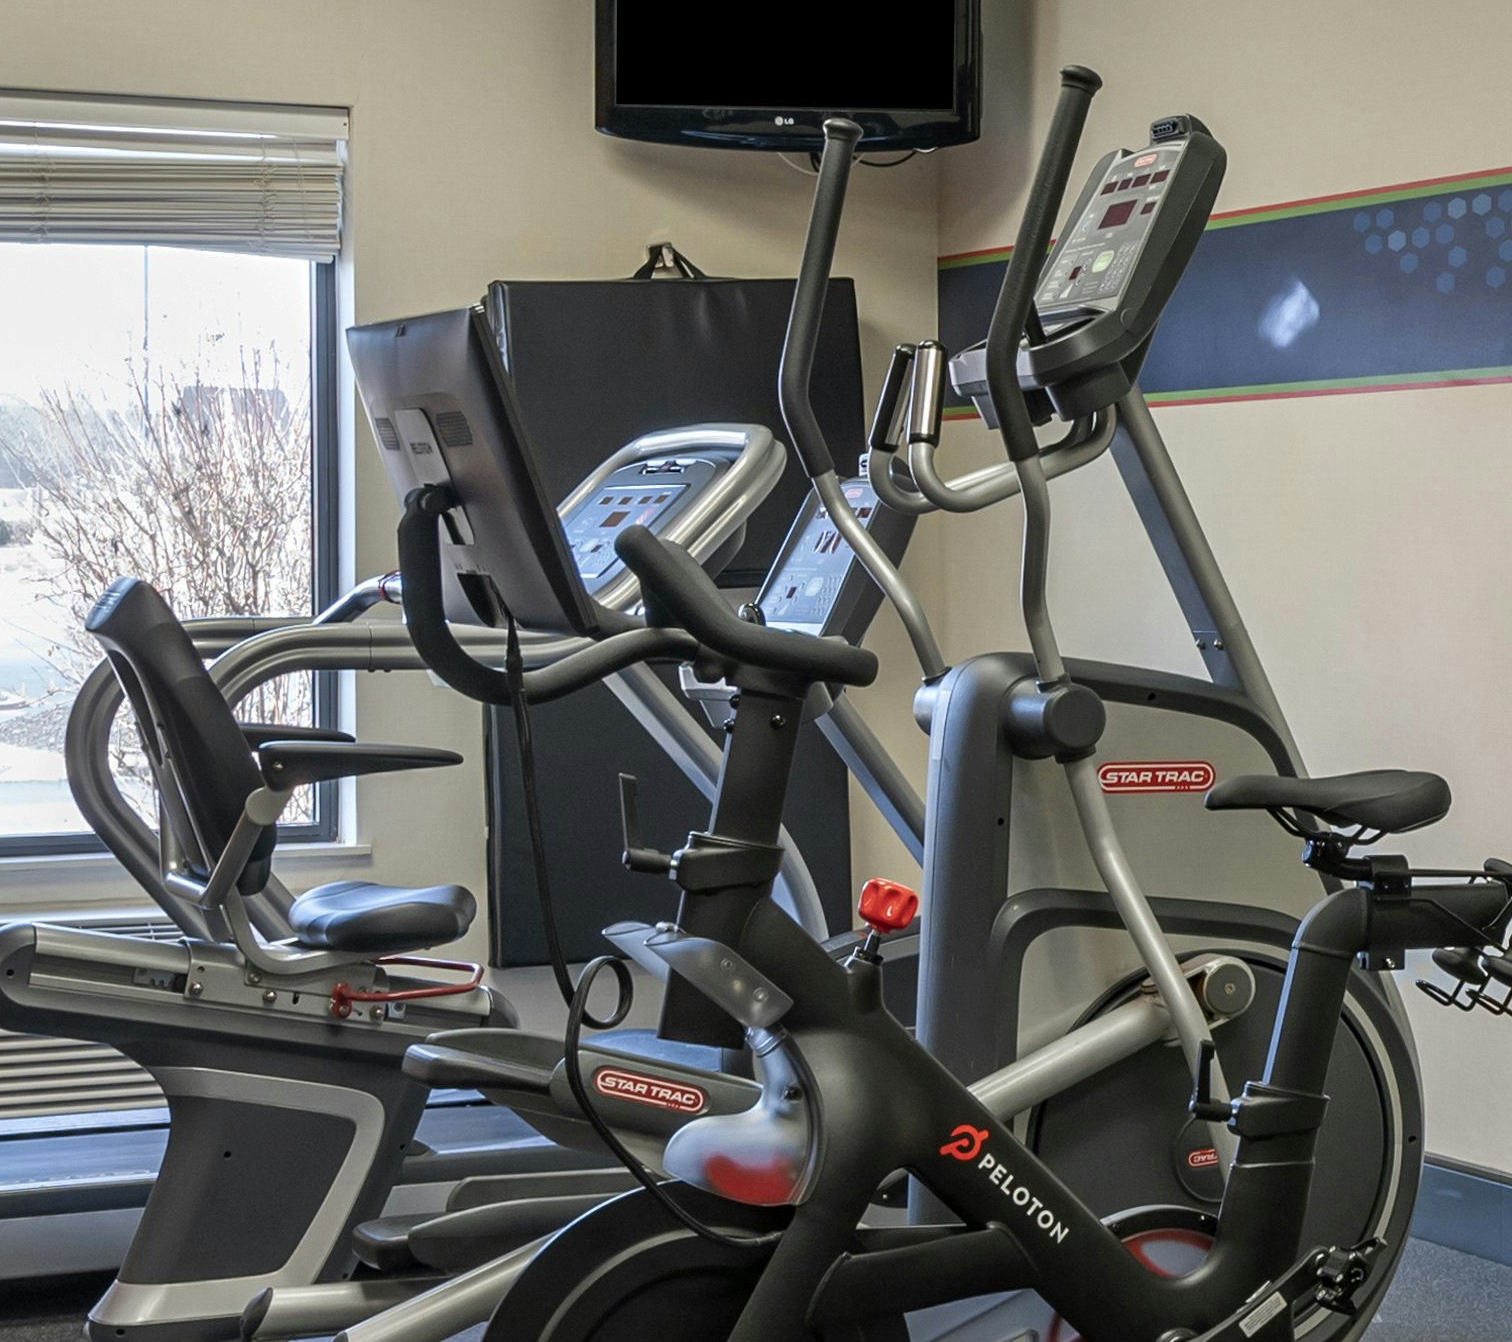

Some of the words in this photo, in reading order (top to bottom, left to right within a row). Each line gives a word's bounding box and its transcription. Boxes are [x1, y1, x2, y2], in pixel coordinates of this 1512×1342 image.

[1103, 770, 1152, 785] STAR
[1154, 769, 1205, 784] TRAC
[603, 1076, 648, 1095] STAR
[649, 1086, 696, 1105] TRAC
[977, 1153, 1070, 1245] PELOTON
